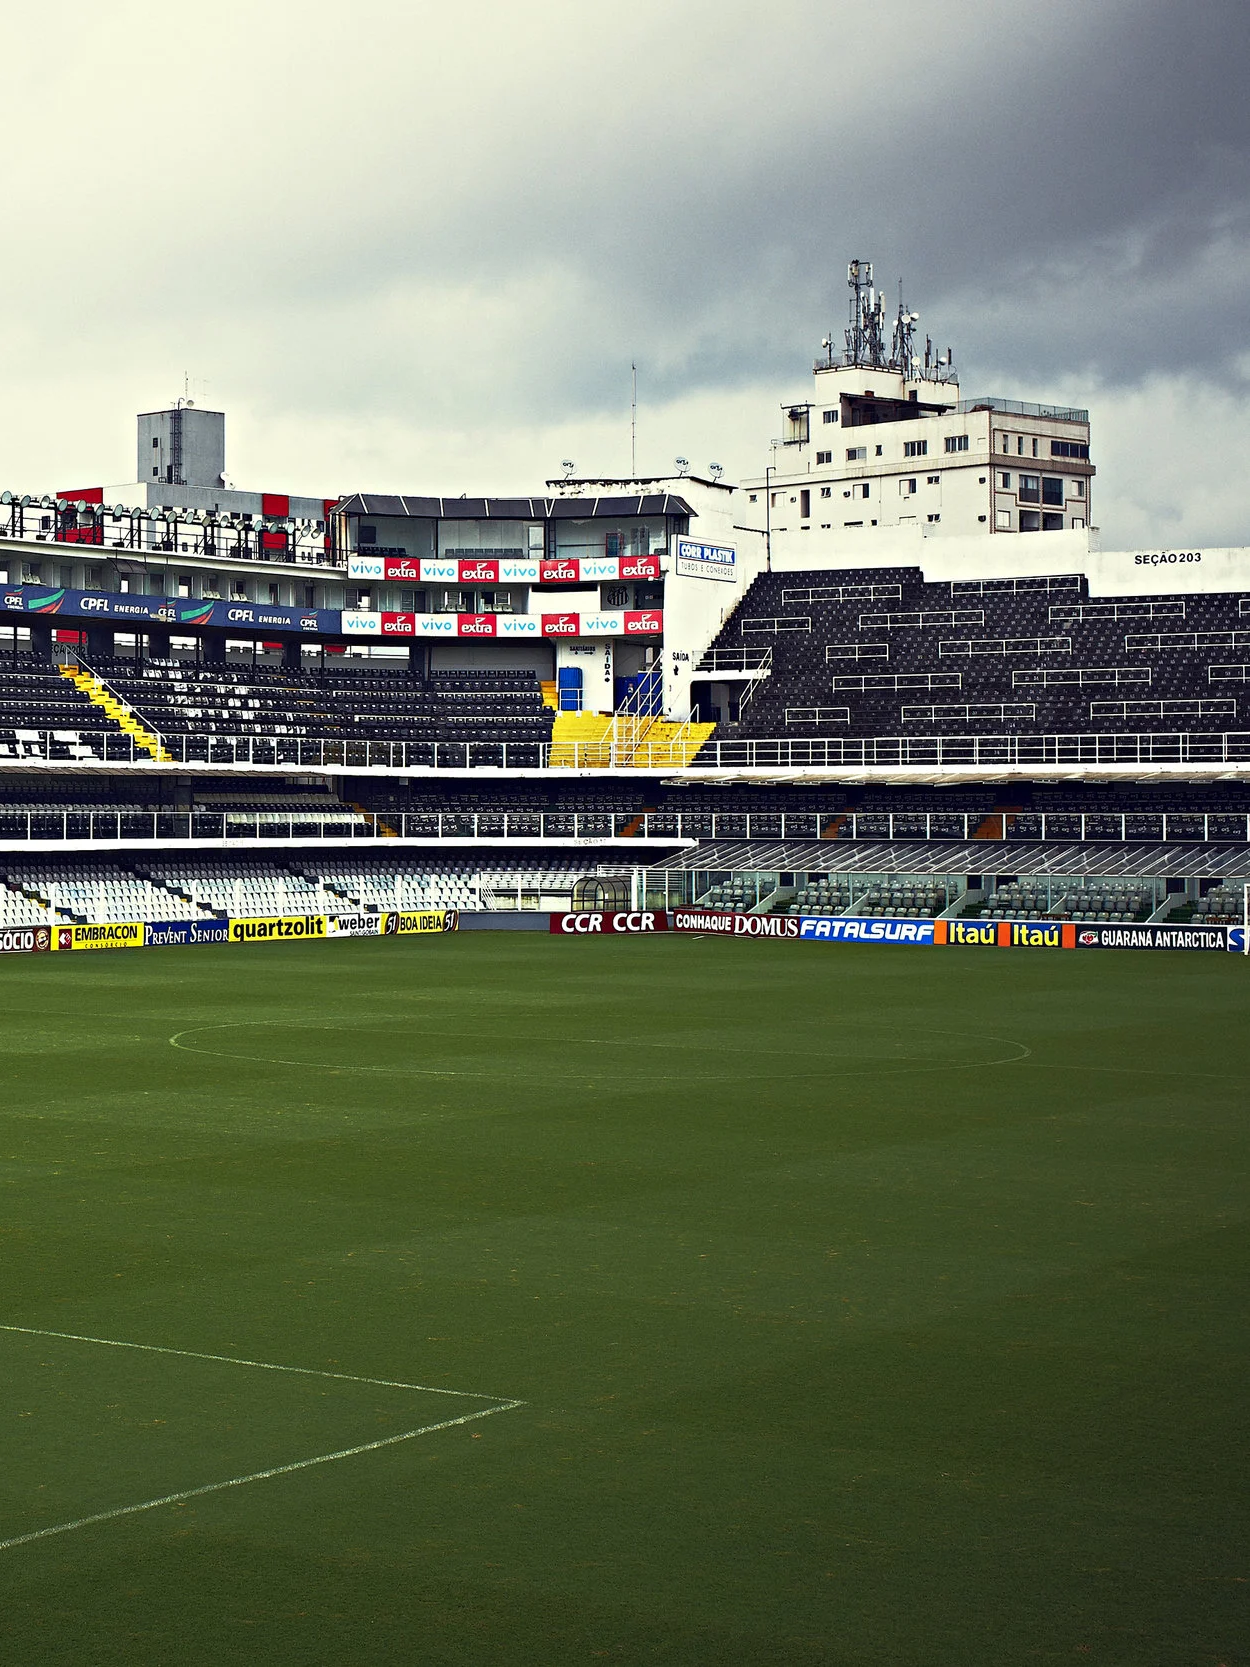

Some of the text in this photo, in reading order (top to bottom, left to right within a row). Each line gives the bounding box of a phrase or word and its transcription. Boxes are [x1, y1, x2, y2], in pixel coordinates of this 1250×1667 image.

[681, 544, 733, 562] CORR PLASTIK
[1134, 552, 1202, 566] SEÇÃO203
[351, 561, 382, 574] vivo
[388, 560, 416, 578] extra
[424, 564, 454, 576] vivo
[462, 562, 494, 580] extra
[503, 561, 536, 576] vivo
[544, 562, 576, 580] extra
[583, 562, 616, 576] vivo
[622, 558, 655, 576] extra
[4, 596, 23, 605] CPFL
[80, 598, 149, 615] CPFL ENERGIA
[228, 608, 290, 625] CPFL ENERGIA
[347, 616, 376, 628] vivo
[384, 616, 412, 632] extra
[422, 618, 452, 631] vivo
[503, 618, 536, 631] vivo
[545, 616, 576, 633] extra
[586, 617, 618, 629] vivo
[627, 614, 659, 631] extra
[461, 617, 492, 634] extra
[672, 650, 689, 661] SAÍDA
[234, 916, 323, 941] quartzolit
[338, 916, 380, 930] weber
[400, 915, 442, 930] BOA IDEIA
[444, 913, 454, 932] 51
[561, 912, 654, 933] CCR CCR
[676, 914, 799, 937] CONHAQUE DOMUS
[800, 920, 934, 941] FATALSURF
[75, 926, 137, 941] EMBRACON
[950, 923, 995, 944] Itaú
[1013, 924, 1058, 946] Itaú
[1102, 929, 1224, 948] GUARANÁ ANTARCTICA
